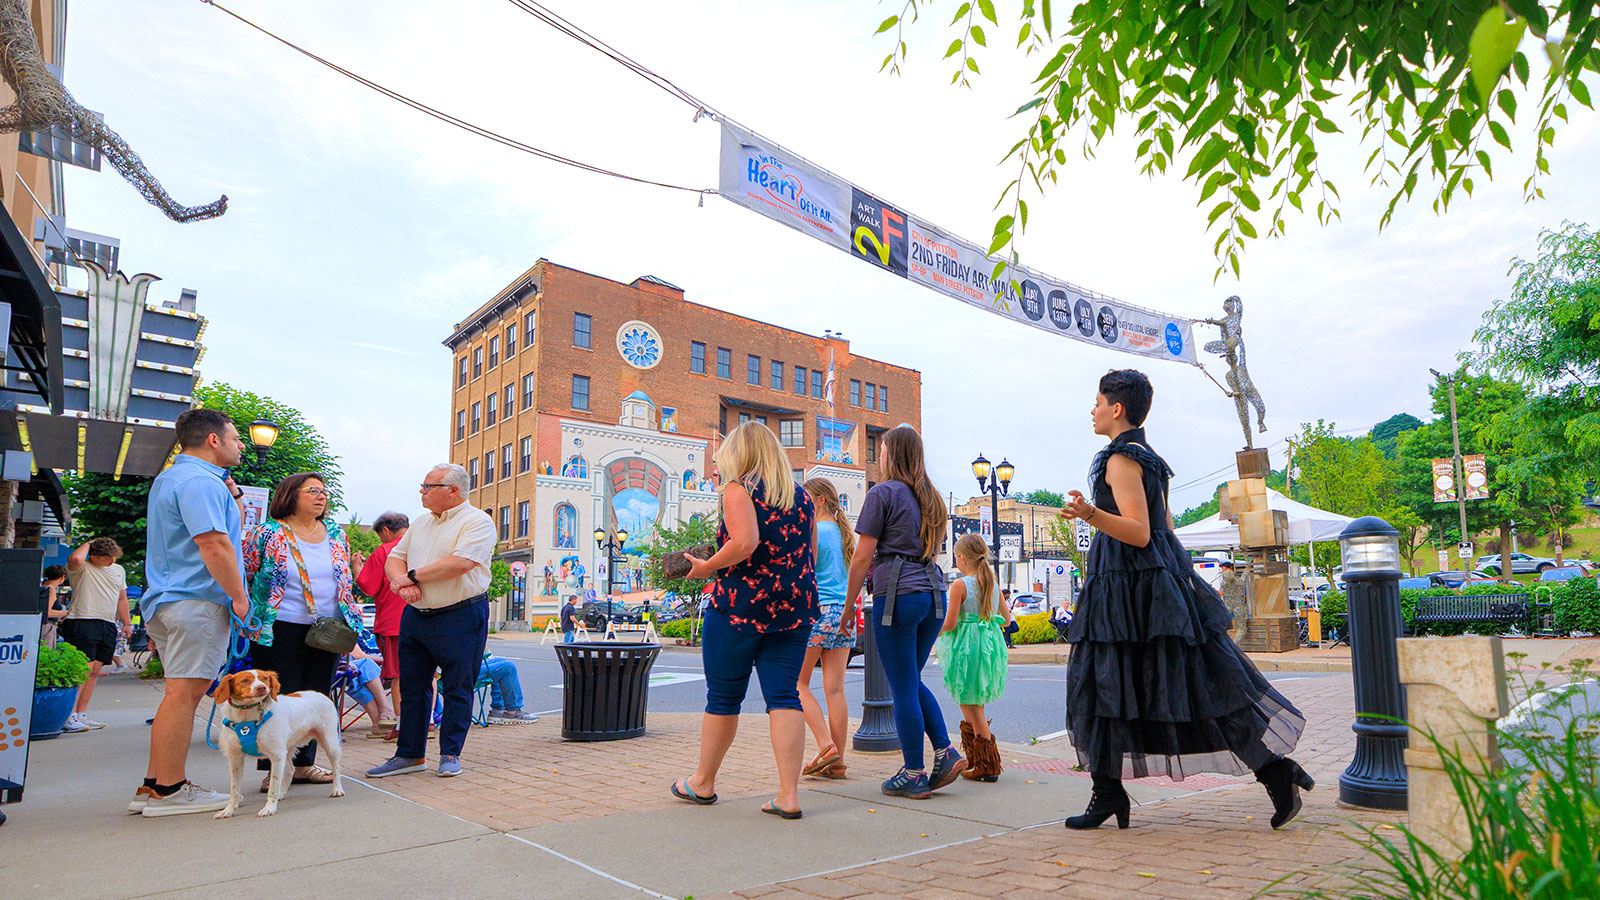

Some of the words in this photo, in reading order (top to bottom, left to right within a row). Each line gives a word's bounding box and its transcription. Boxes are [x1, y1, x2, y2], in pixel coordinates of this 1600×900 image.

[770, 156, 783, 169] The
[747, 157, 797, 200] Heart
[858, 202, 875, 216] ART
[857, 212, 880, 229] WALK
[912, 230, 923, 245] CITY
[924, 237, 931, 248] OF
[931, 240, 959, 259] PITTSTON
[912, 241, 934, 267] 2ND
[935, 252, 971, 283] FRIDAY
[972, 269, 990, 292] ART
[991, 279, 1017, 302] WALK
[932, 271, 944, 285] MAIN
[963, 285, 984, 301] PITTSTON
[1025, 286, 1039, 300] MAY
[1026, 300, 1039, 314] 9TH
[1052, 297, 1067, 310] JUNE
[1052, 310, 1068, 323] 13TH
[1079, 534, 1089, 548] 25
